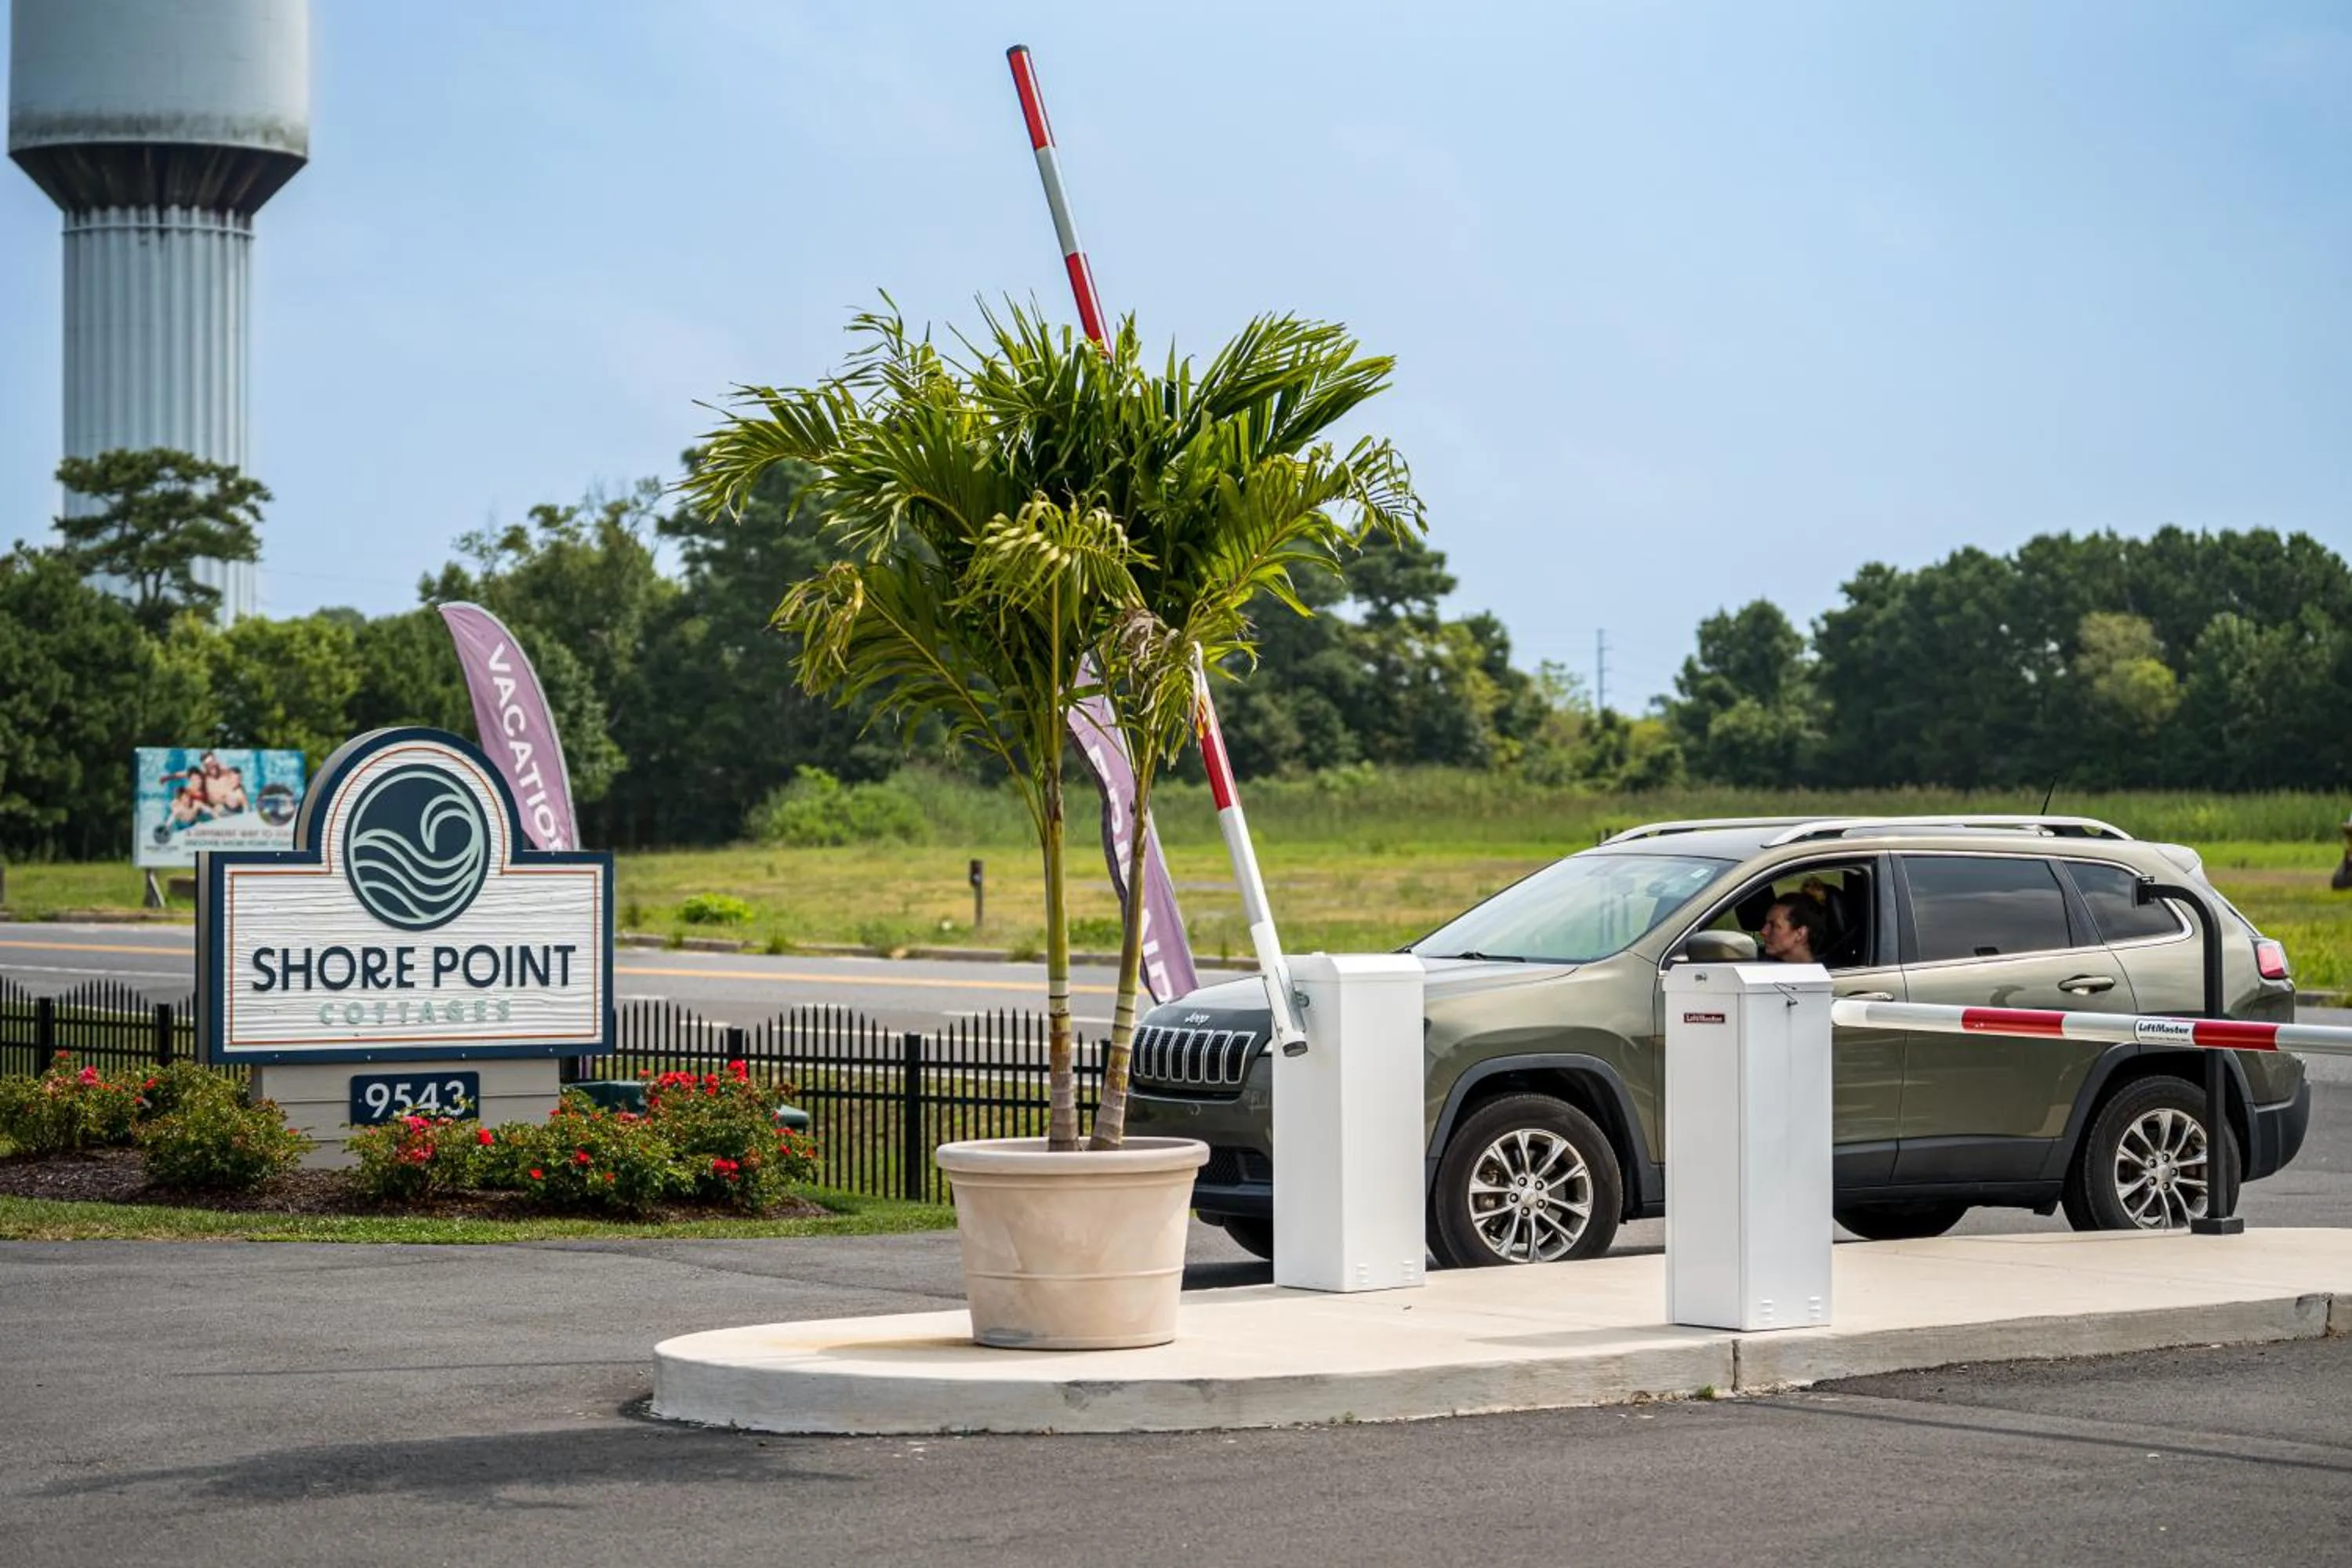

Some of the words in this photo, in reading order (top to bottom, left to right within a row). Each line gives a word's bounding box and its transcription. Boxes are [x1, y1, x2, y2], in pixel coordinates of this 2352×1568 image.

[488, 642, 564, 851] VACATIO
[252, 945, 416, 992] SHORE
[433, 944, 577, 989] POINT
[318, 999, 511, 1025] COTTAGES
[2138, 1022, 2190, 1034] LiftMaster
[365, 1080, 466, 1120] 9543
